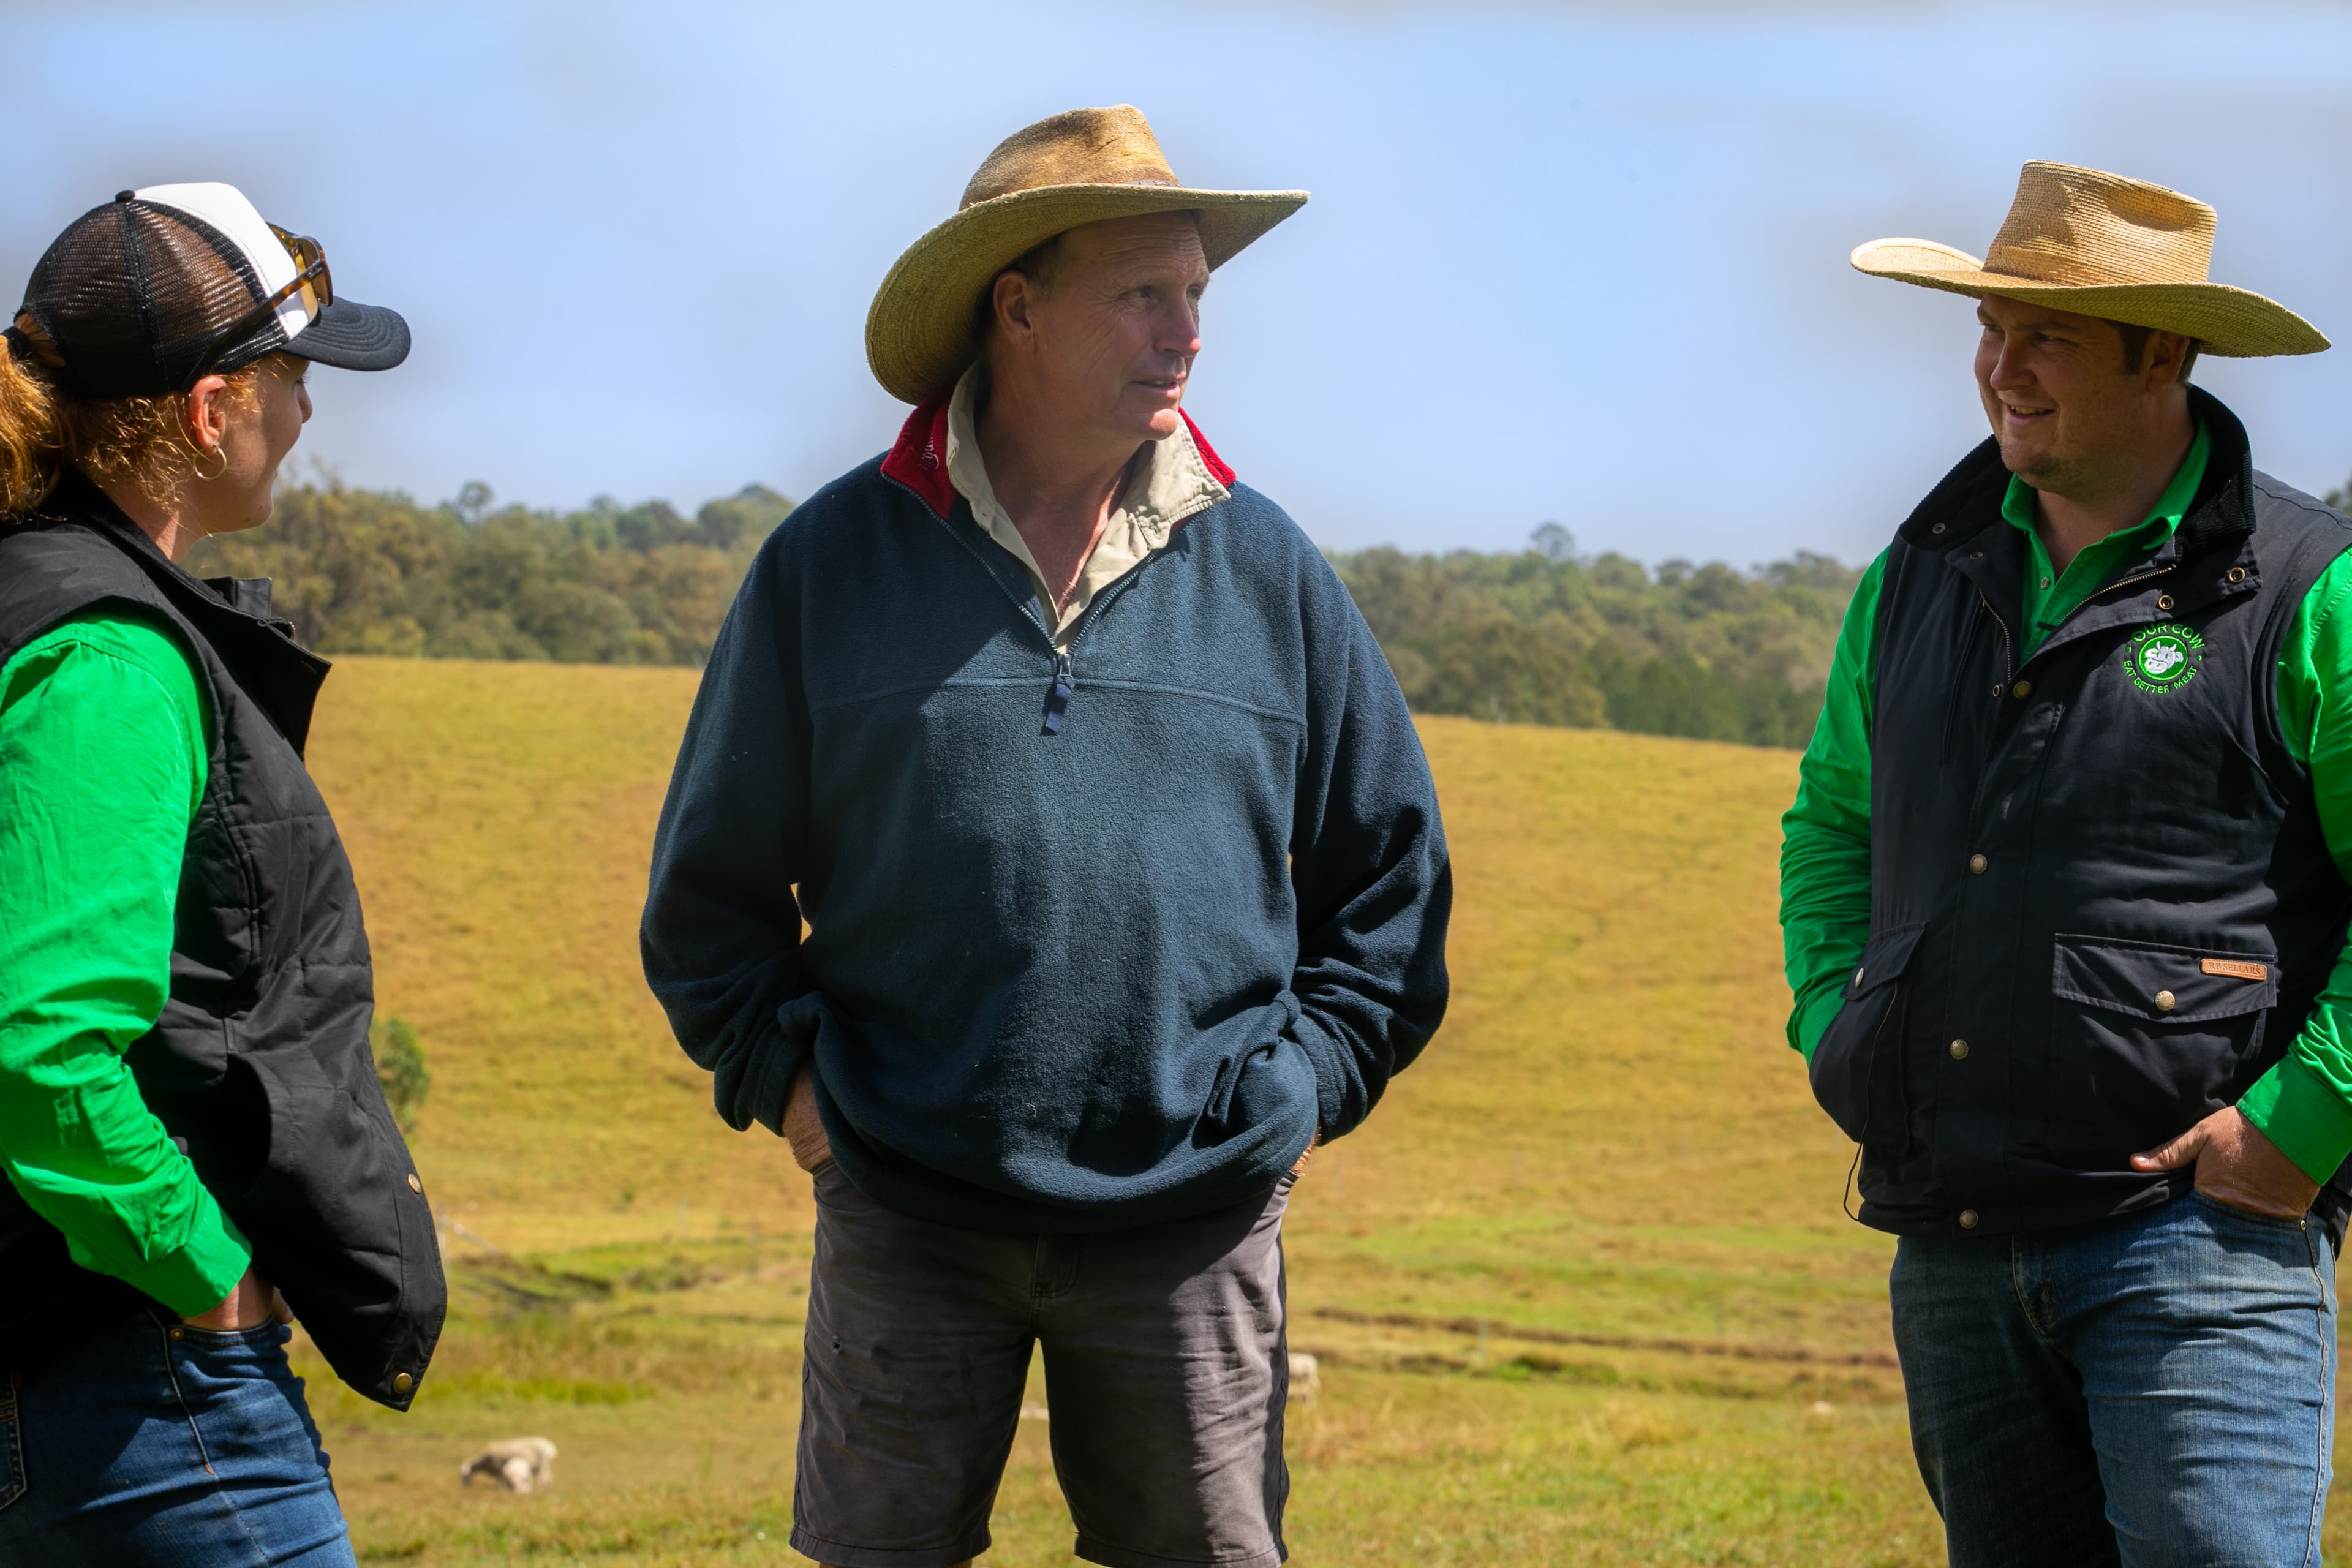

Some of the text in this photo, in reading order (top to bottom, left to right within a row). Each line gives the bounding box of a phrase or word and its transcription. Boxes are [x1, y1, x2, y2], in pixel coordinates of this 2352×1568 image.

[2132, 622, 2205, 649] OUR COW
[2124, 660, 2198, 693] EAT BETTER MEAT
[2223, 963, 2260, 975] SELLARS
